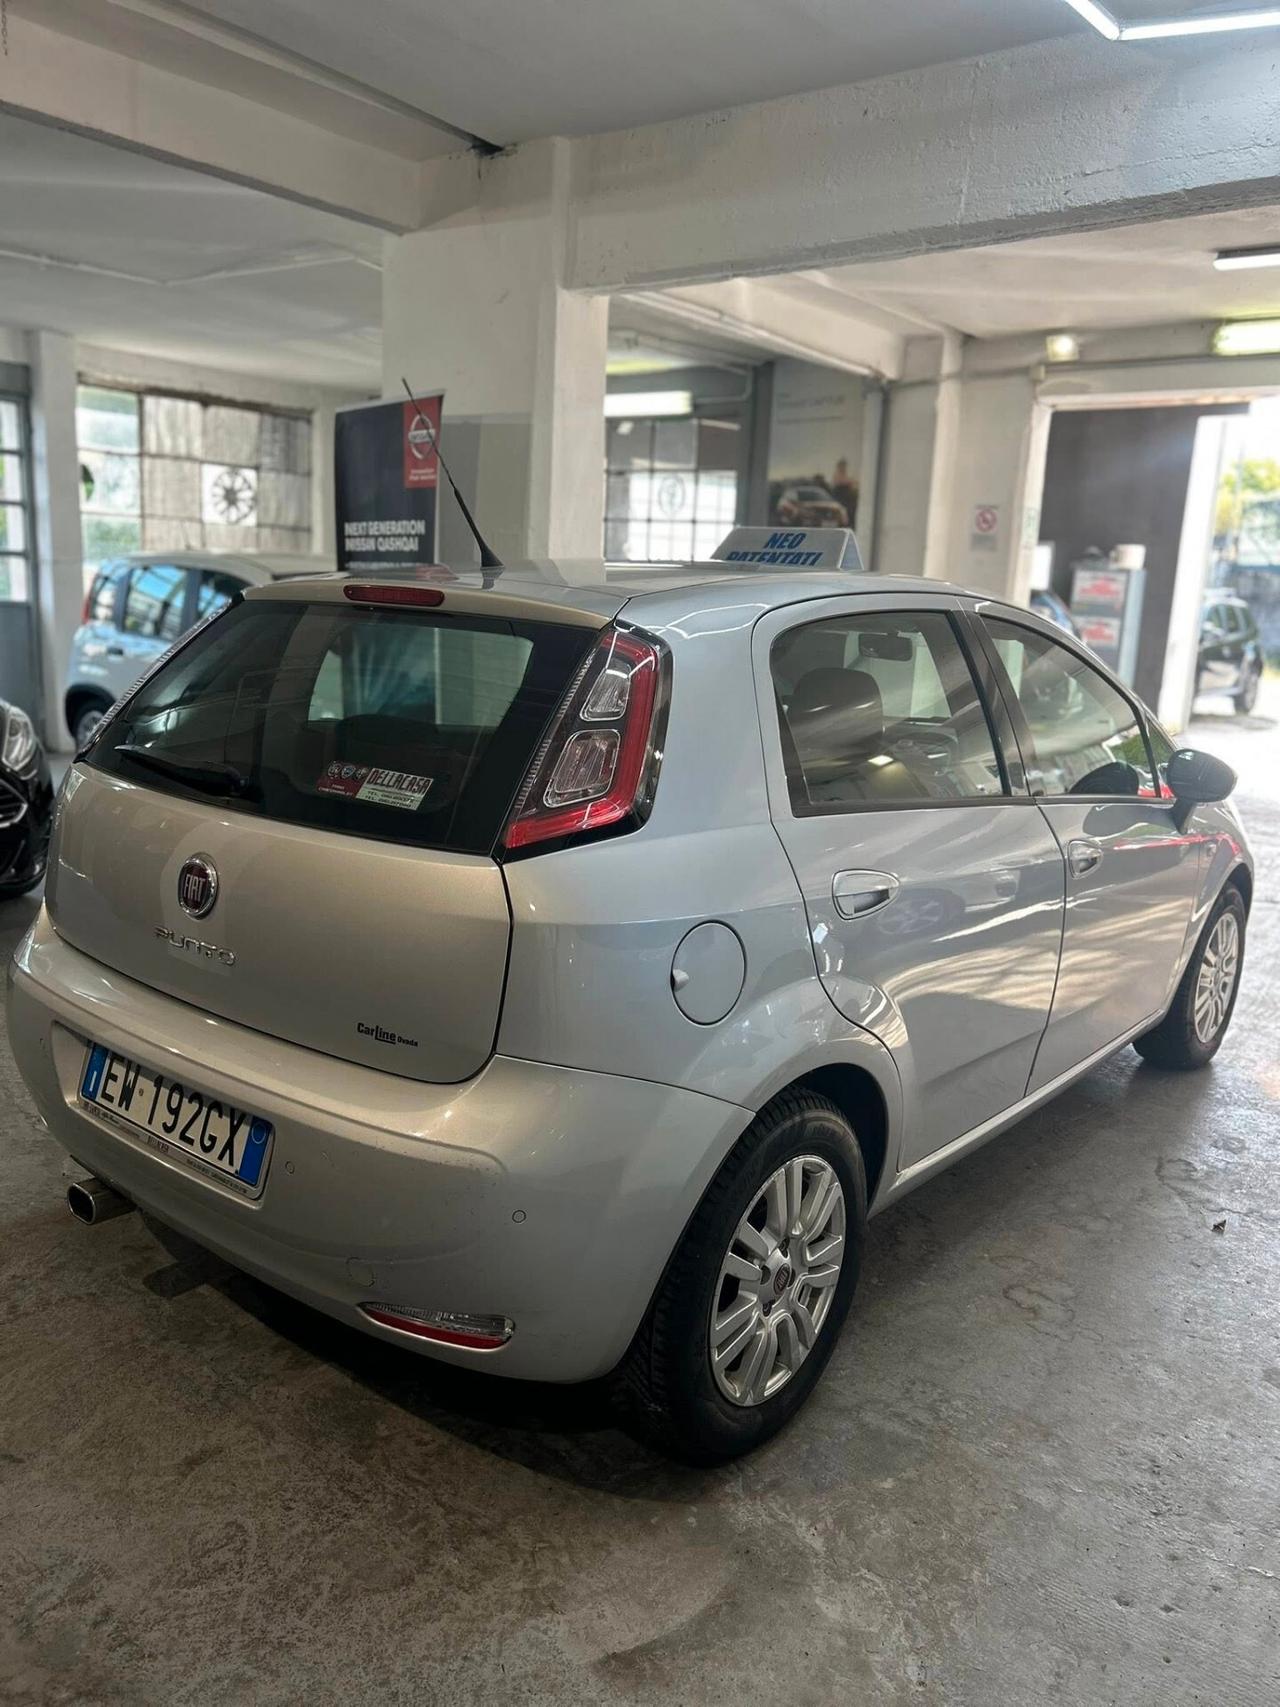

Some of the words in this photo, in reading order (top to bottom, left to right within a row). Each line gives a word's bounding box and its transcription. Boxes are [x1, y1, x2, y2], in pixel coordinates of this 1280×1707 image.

[344, 521, 366, 536] NEXT
[368, 520, 426, 536] GENERATION
[377, 536, 419, 552] QASHQAI
[764, 532, 807, 549] NEO
[726, 551, 824, 566] PATENTATI
[366, 769, 431, 795] DELLACASA
[184, 873, 206, 903] FIAT
[357, 1022, 396, 1045] CarLine
[101, 1052, 141, 1112] EW
[148, 1074, 246, 1167] 192GX
